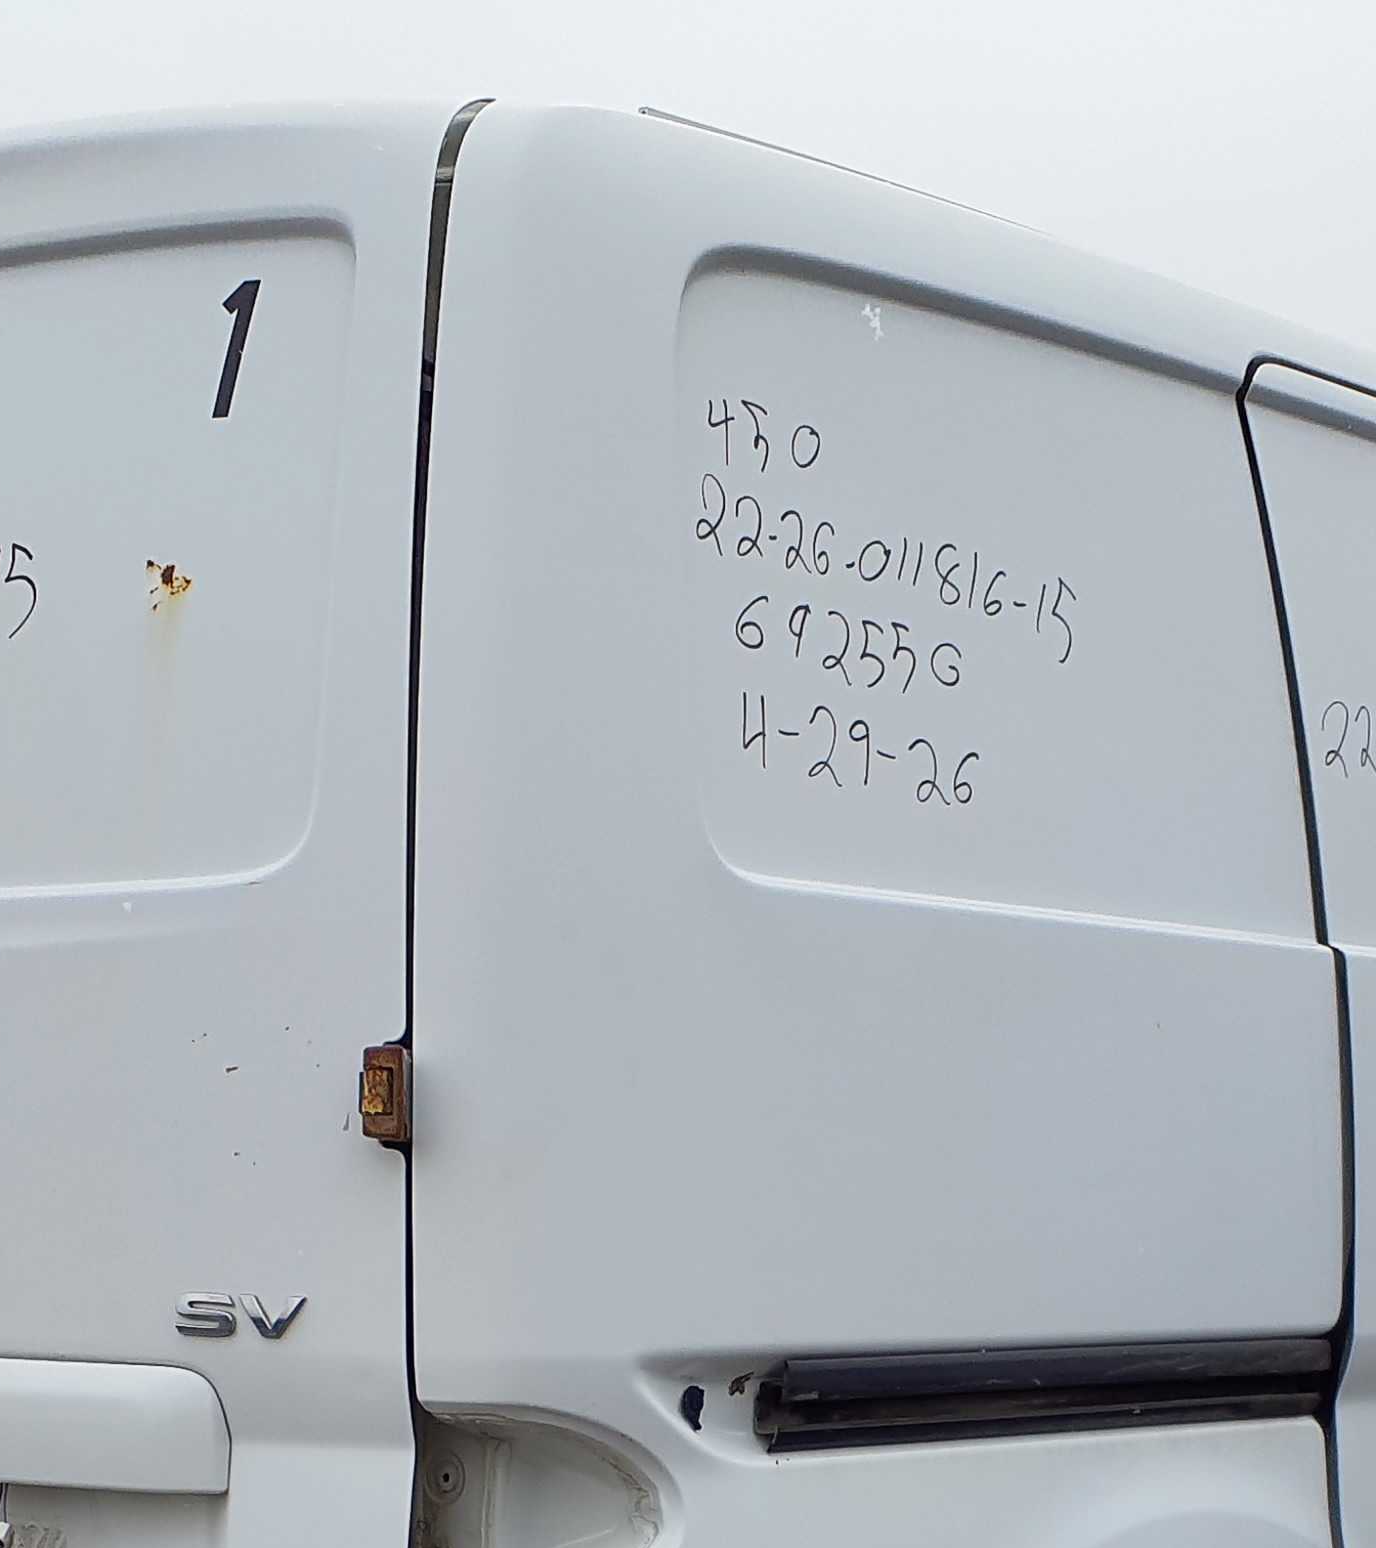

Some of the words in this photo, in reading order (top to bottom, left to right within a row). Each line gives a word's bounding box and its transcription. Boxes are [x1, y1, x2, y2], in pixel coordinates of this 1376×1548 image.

[212, 279, 262, 419] 1
[707, 398, 820, 472] 450
[696, 473, 1077, 663] 22-26-011816-15
[741, 690, 980, 806] 4-29-26
[175, 1292, 307, 1340] SV
